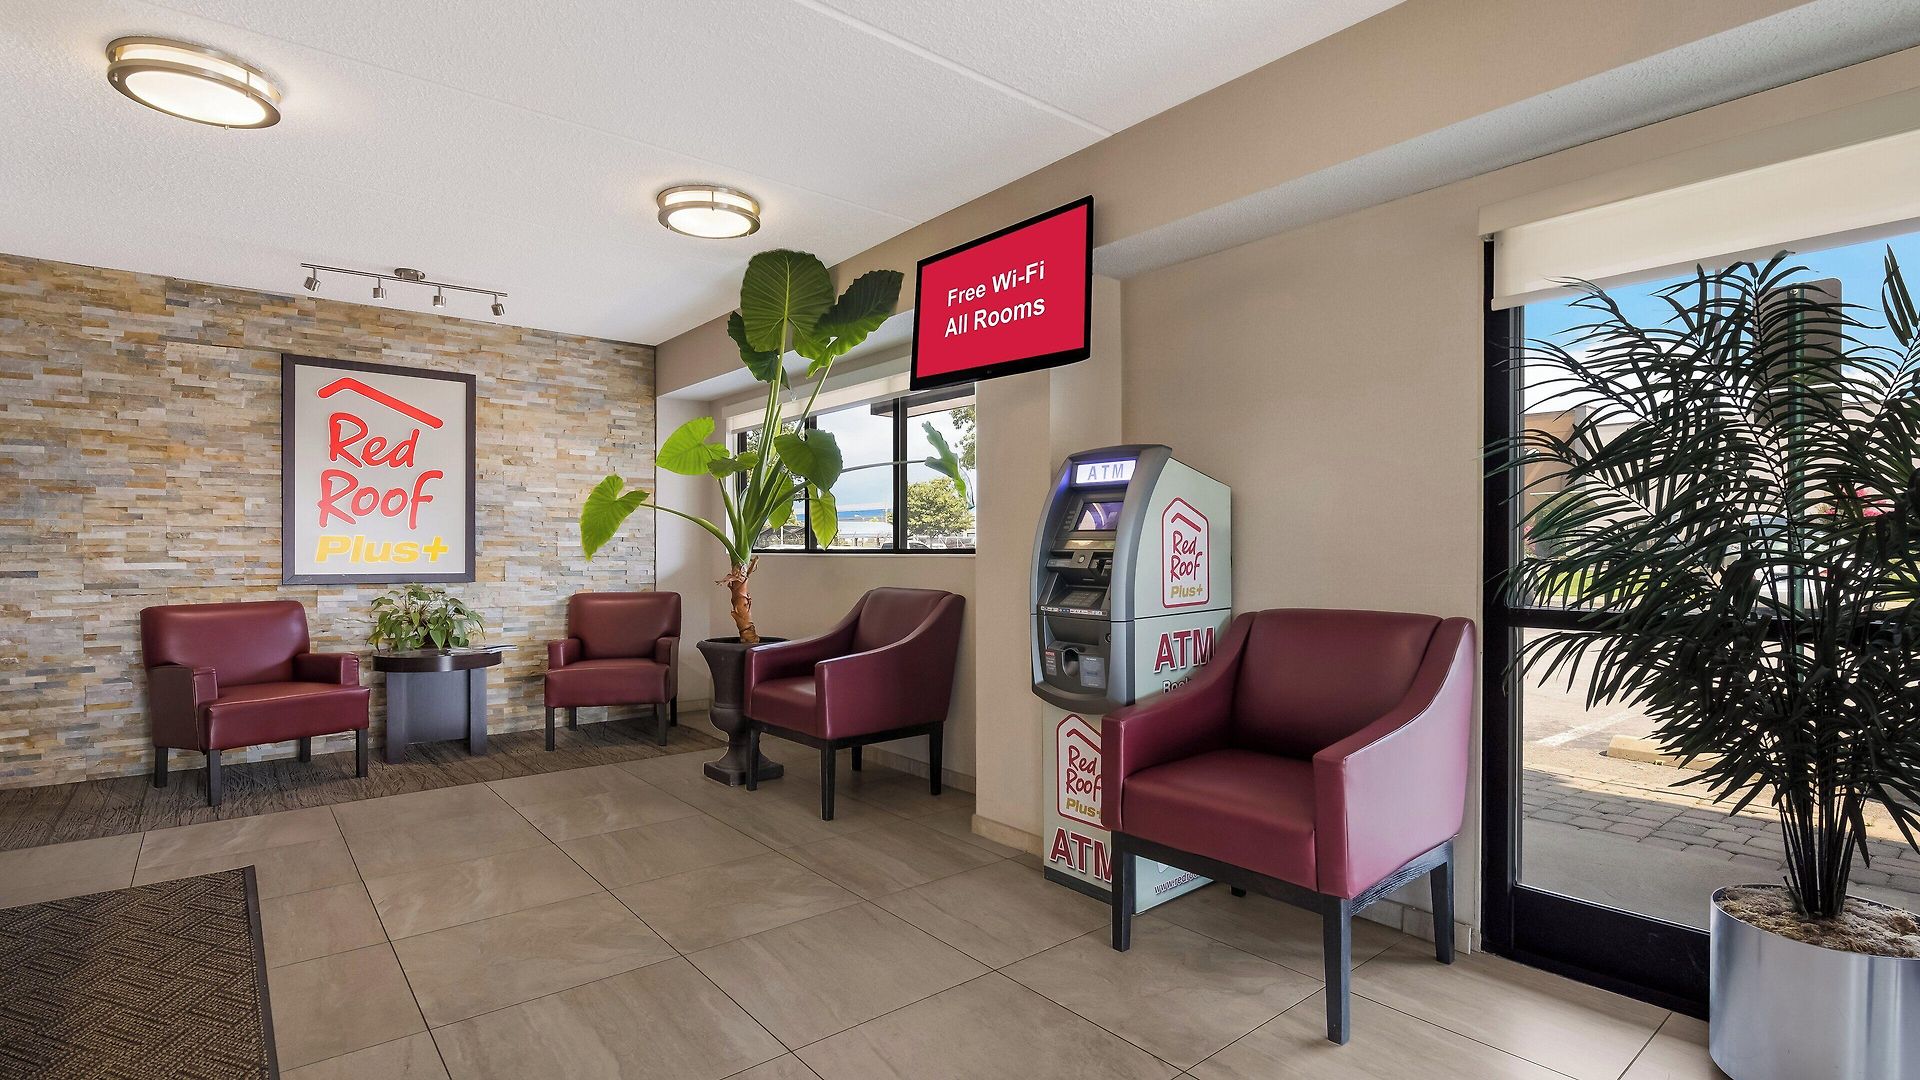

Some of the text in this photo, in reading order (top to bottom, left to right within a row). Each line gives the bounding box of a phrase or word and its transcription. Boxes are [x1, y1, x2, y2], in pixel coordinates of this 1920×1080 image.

[947, 260, 1045, 307] Free Wi-Fi
[944, 298, 1046, 338] All Rooms
[328, 412, 420, 469] Red
[1087, 463, 1124, 481] ATM
[316, 468, 444, 530] Roof
[315, 535, 449, 564] Plus+
[1172, 530, 1198, 556] Red
[1170, 551, 1204, 583] Roof
[1153, 625, 1216, 673] ATM
[1068, 744, 1098, 776] Red
[1066, 767, 1102, 803] Roof
[1049, 826, 1113, 884] ATM
